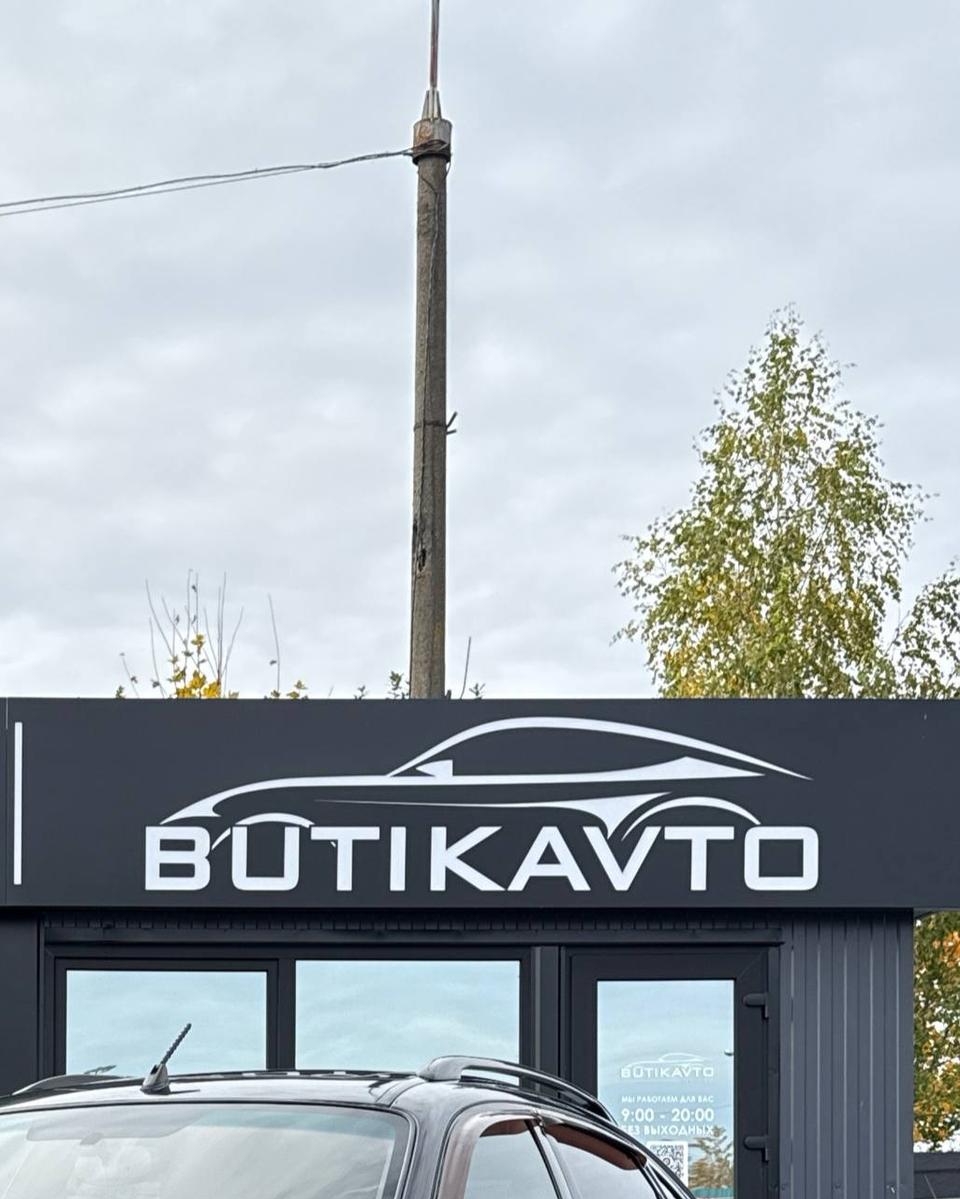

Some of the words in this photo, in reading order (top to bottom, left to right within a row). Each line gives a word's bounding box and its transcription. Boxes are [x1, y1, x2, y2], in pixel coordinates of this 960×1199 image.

[144, 825, 820, 891] BUTIKAVTO
[620, 1067, 714, 1078] BUTIKAVTO
[621, 1108, 654, 1122] 9:00
[671, 1108, 714, 1122] 20:00
[644, 1124, 714, 1135] ВЫХОДНЫХ
